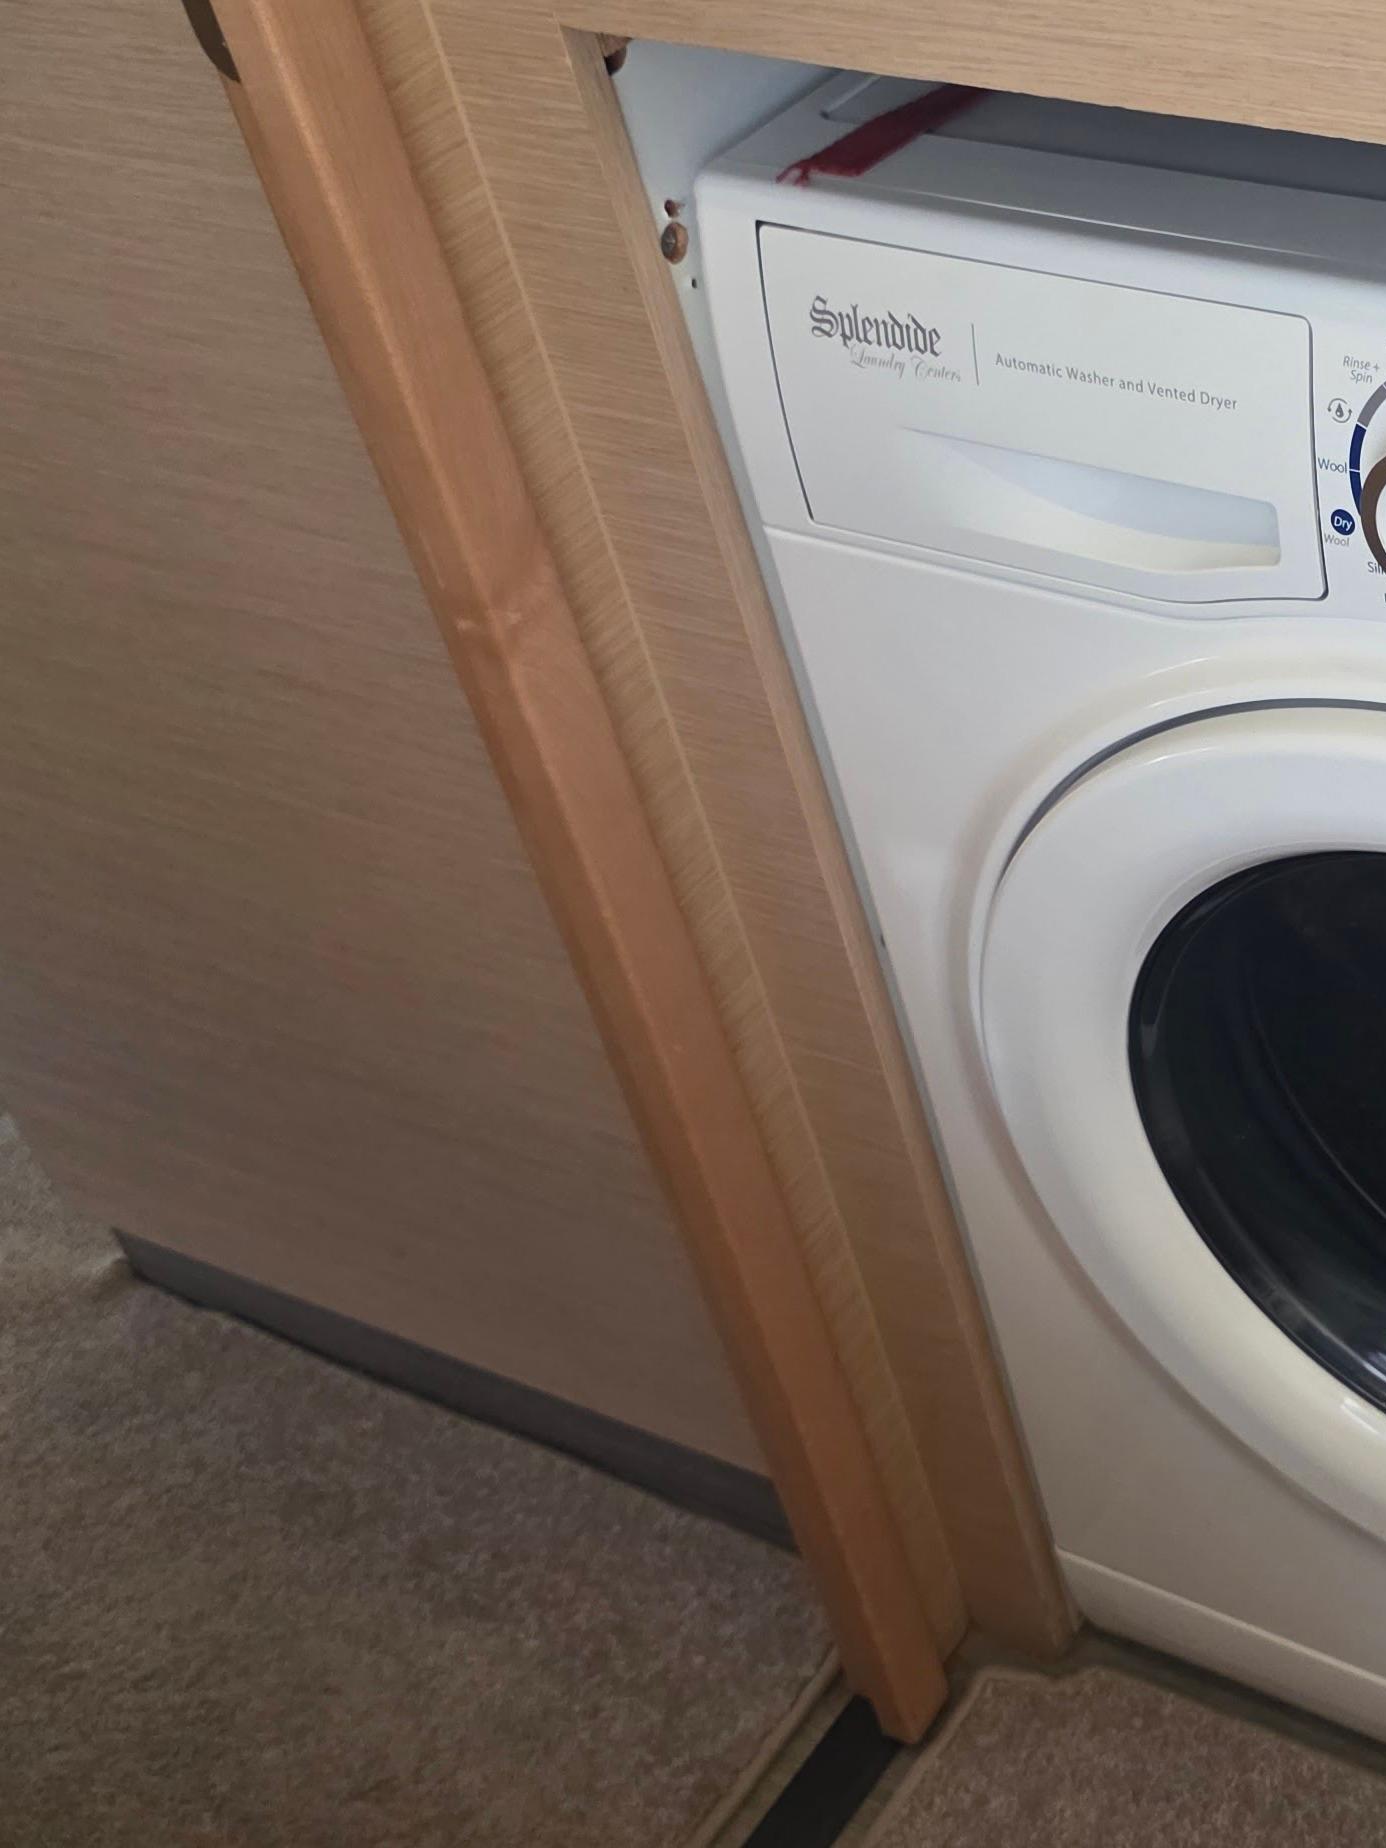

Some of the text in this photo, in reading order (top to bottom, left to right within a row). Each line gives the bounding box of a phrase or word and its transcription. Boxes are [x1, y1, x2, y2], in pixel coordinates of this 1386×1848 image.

[810, 295, 942, 357] Splendide
[1343, 356, 1370, 372] Rinse
[995, 352, 1238, 412] Automatic Washer and Vented Dryer
[1350, 369, 1372, 384] Spin
[1318, 458, 1347, 474] Wool
[1334, 516, 1352, 532] Dry
[1324, 533, 1350, 548] Wool
[1367, 561, 1384, 575] Sil
